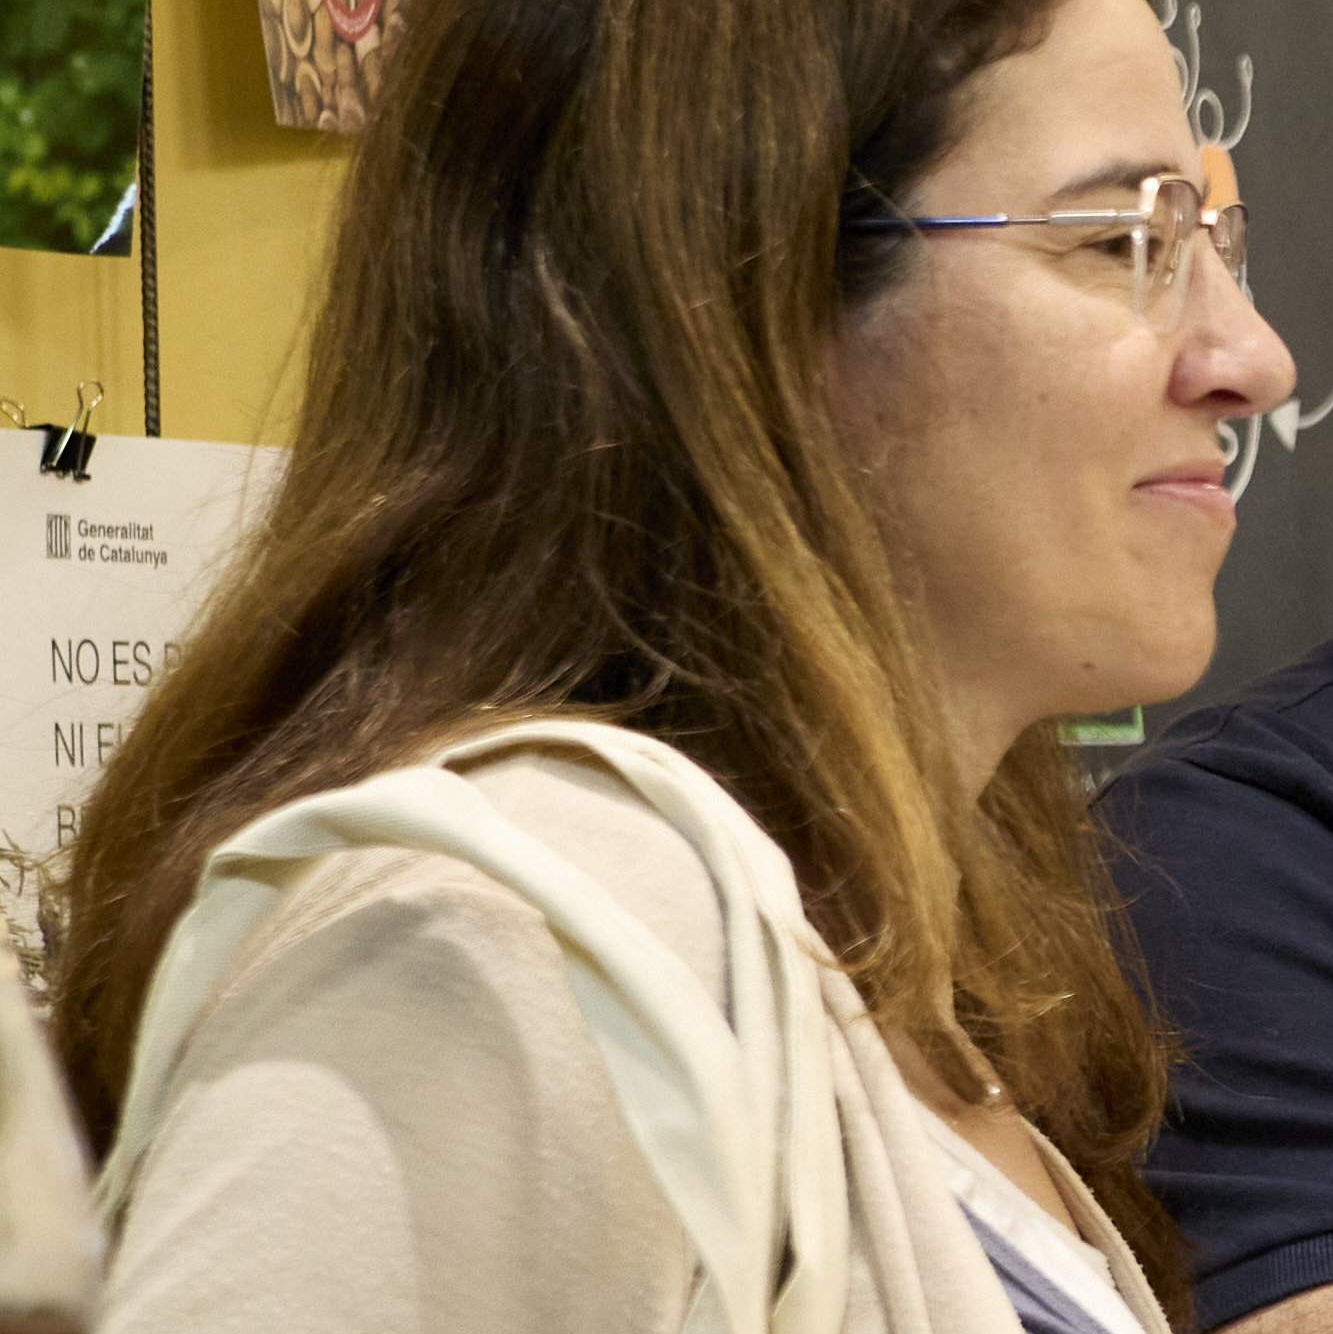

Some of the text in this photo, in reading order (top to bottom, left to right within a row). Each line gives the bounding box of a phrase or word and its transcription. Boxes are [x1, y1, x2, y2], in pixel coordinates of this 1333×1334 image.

[78, 519, 154, 541] Generalitat
[79, 543, 168, 570] de Catalunya
[51, 638, 100, 685] NO
[112, 640, 152, 686] ES
[54, 722, 84, 767] NI
